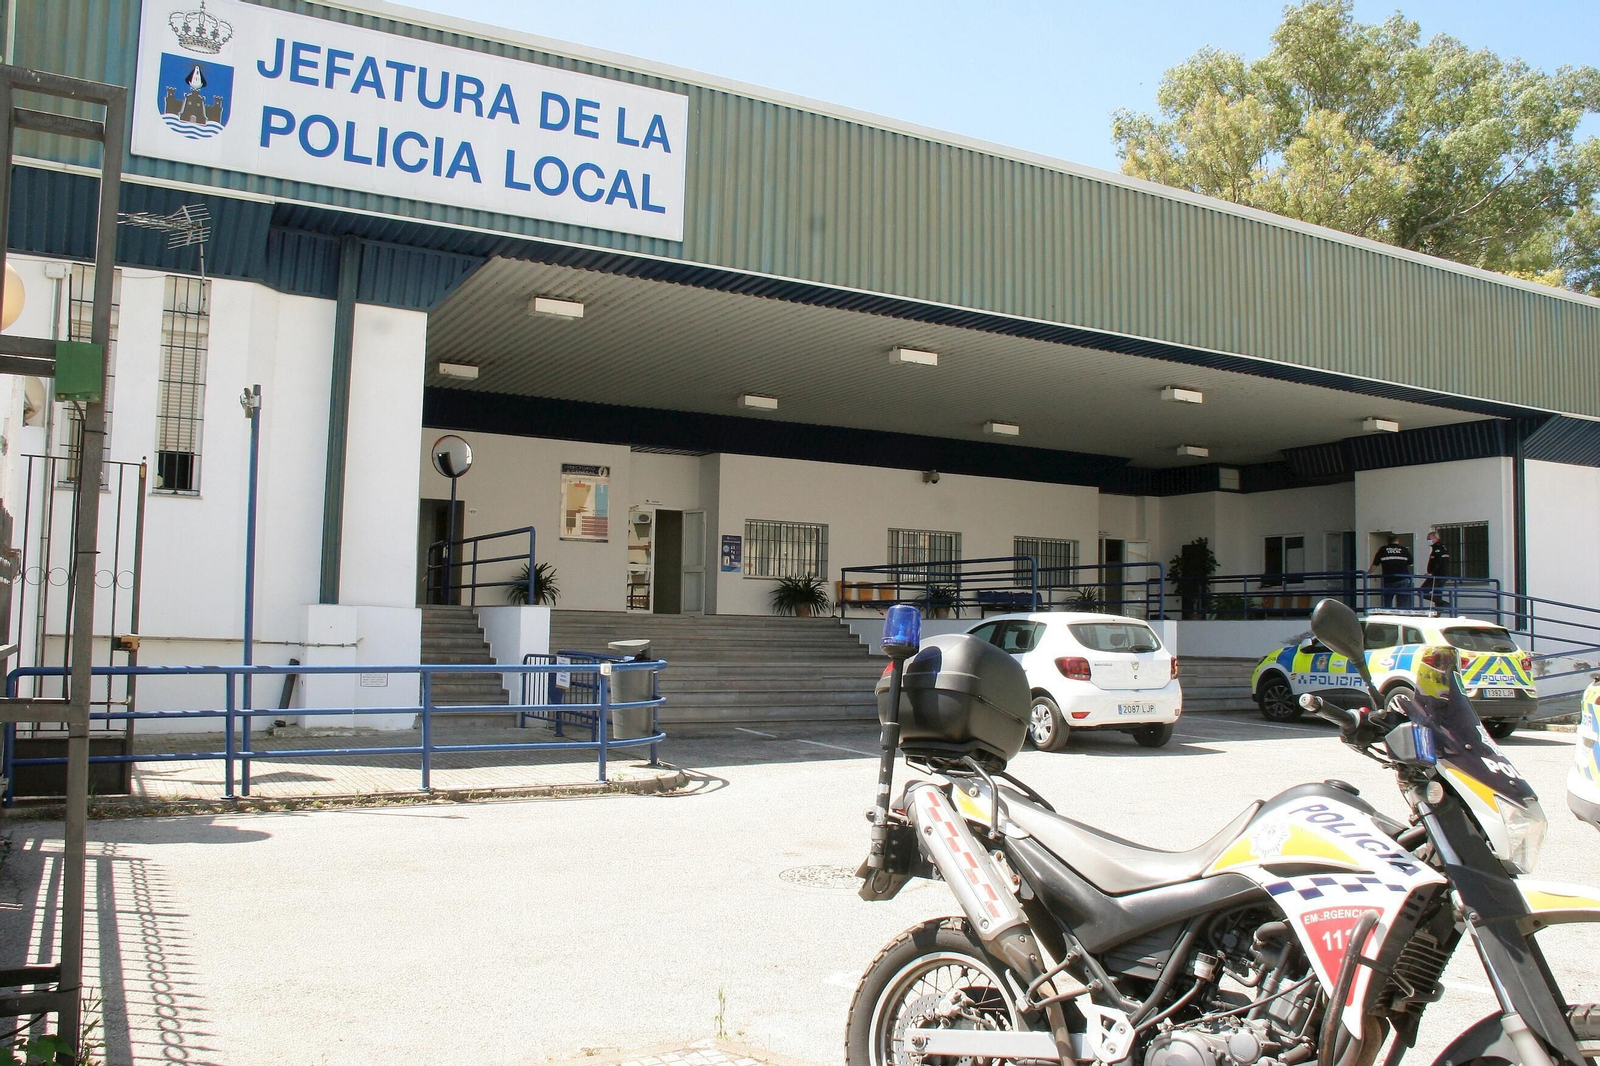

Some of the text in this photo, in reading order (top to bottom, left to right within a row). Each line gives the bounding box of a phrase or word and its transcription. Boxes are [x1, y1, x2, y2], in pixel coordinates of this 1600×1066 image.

[256, 38, 671, 153] JEFATURA DE LA
[260, 105, 666, 214] POLICIA LOCAL
[1123, 705, 1155, 713] 2087 LJP
[1310, 675, 1362, 687] POLICIA
[1288, 804, 1422, 877] POLICIA
